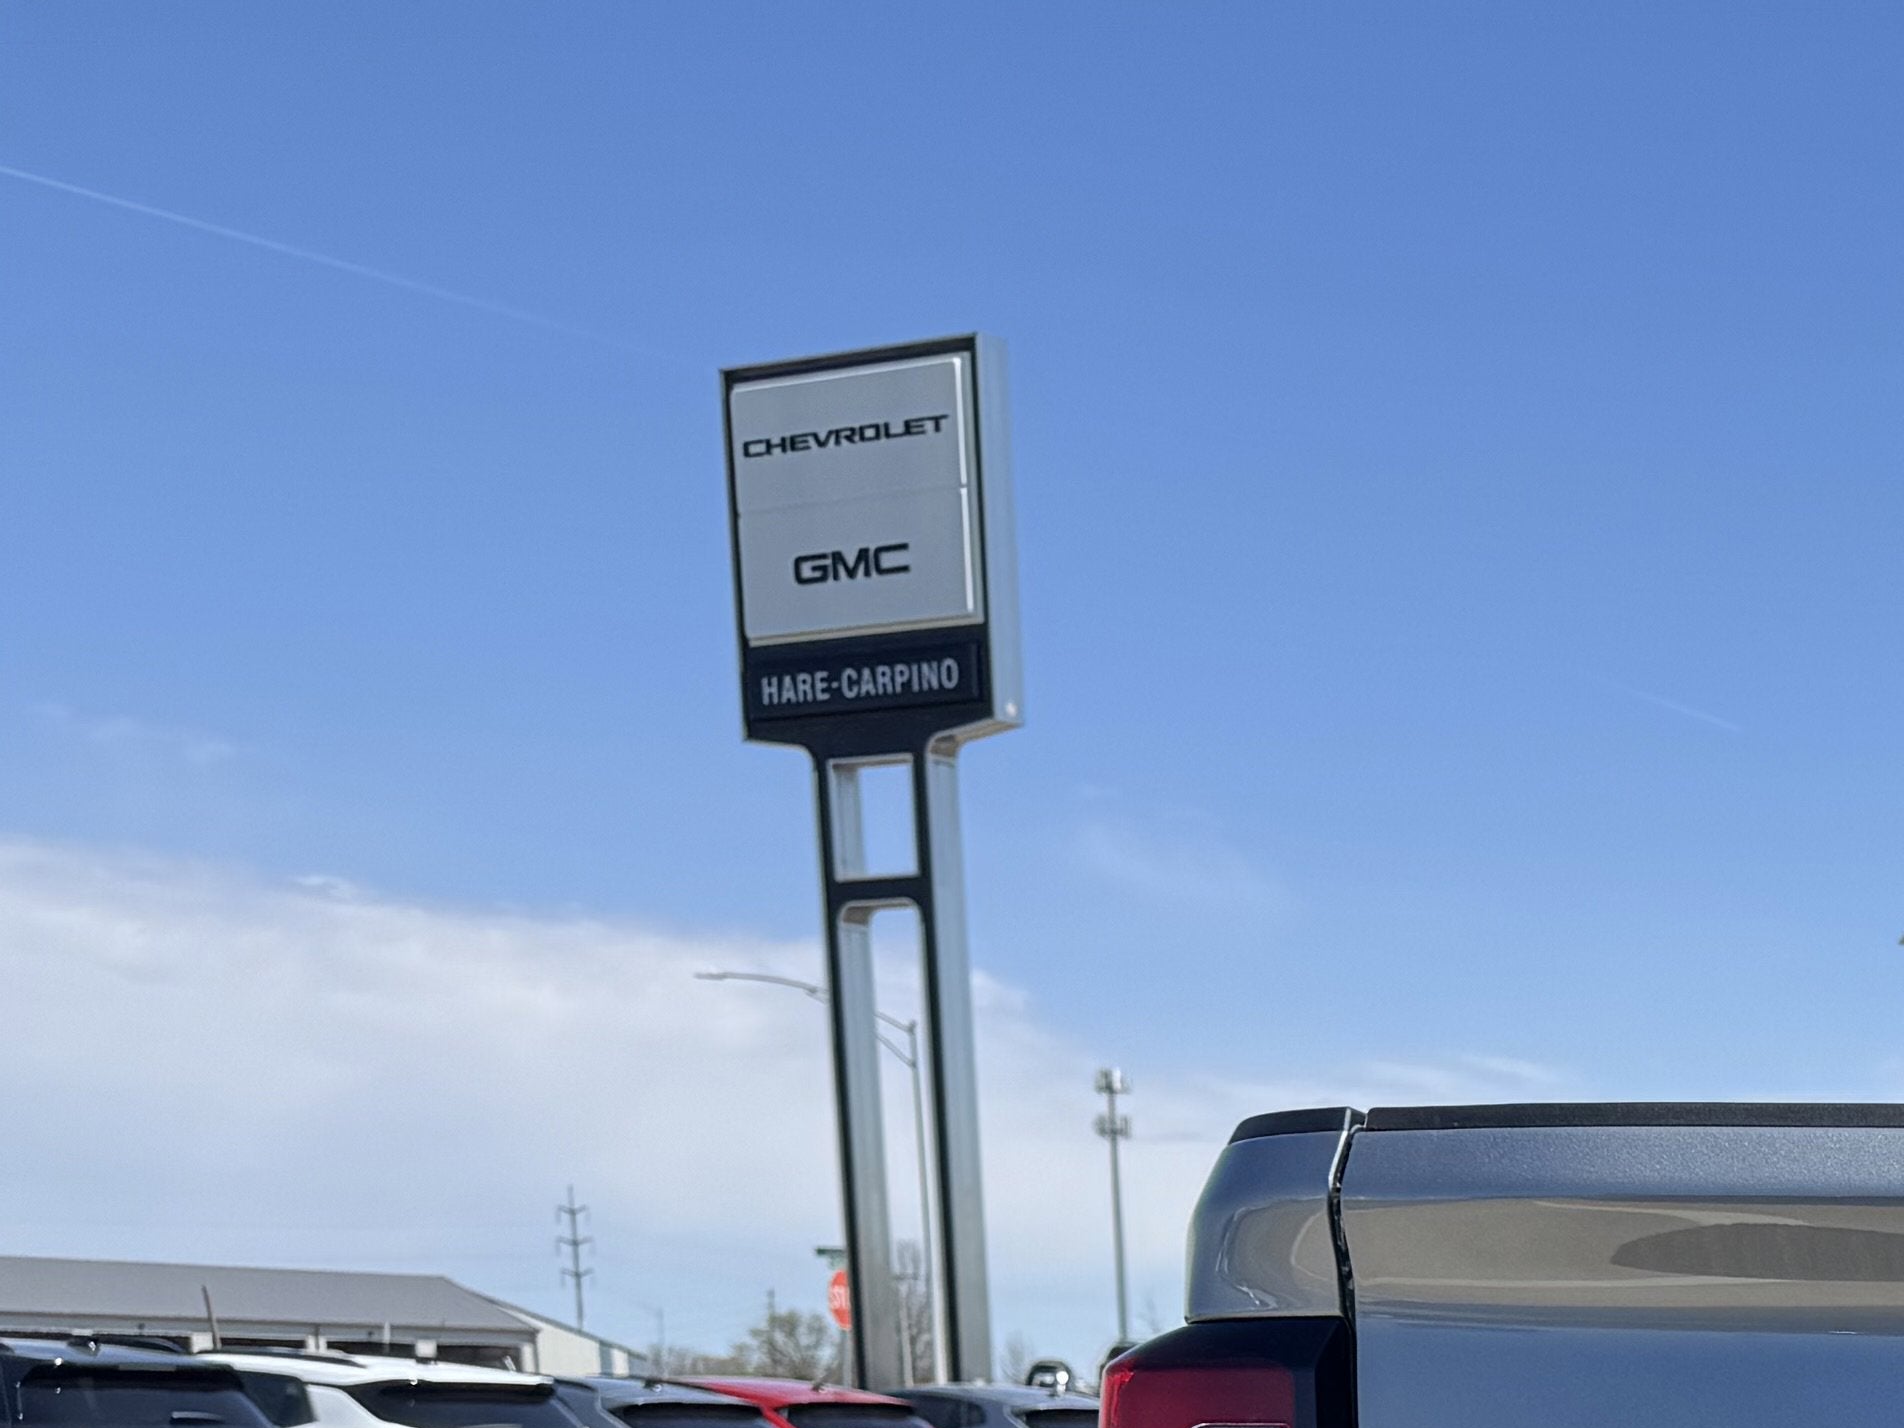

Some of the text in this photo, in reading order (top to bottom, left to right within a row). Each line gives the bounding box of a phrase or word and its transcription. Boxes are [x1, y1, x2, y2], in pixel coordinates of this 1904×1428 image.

[743, 414, 949, 458] CHEVROLET
[794, 543, 910, 585] GMC
[761, 657, 959, 706] HARE-CARPINO
